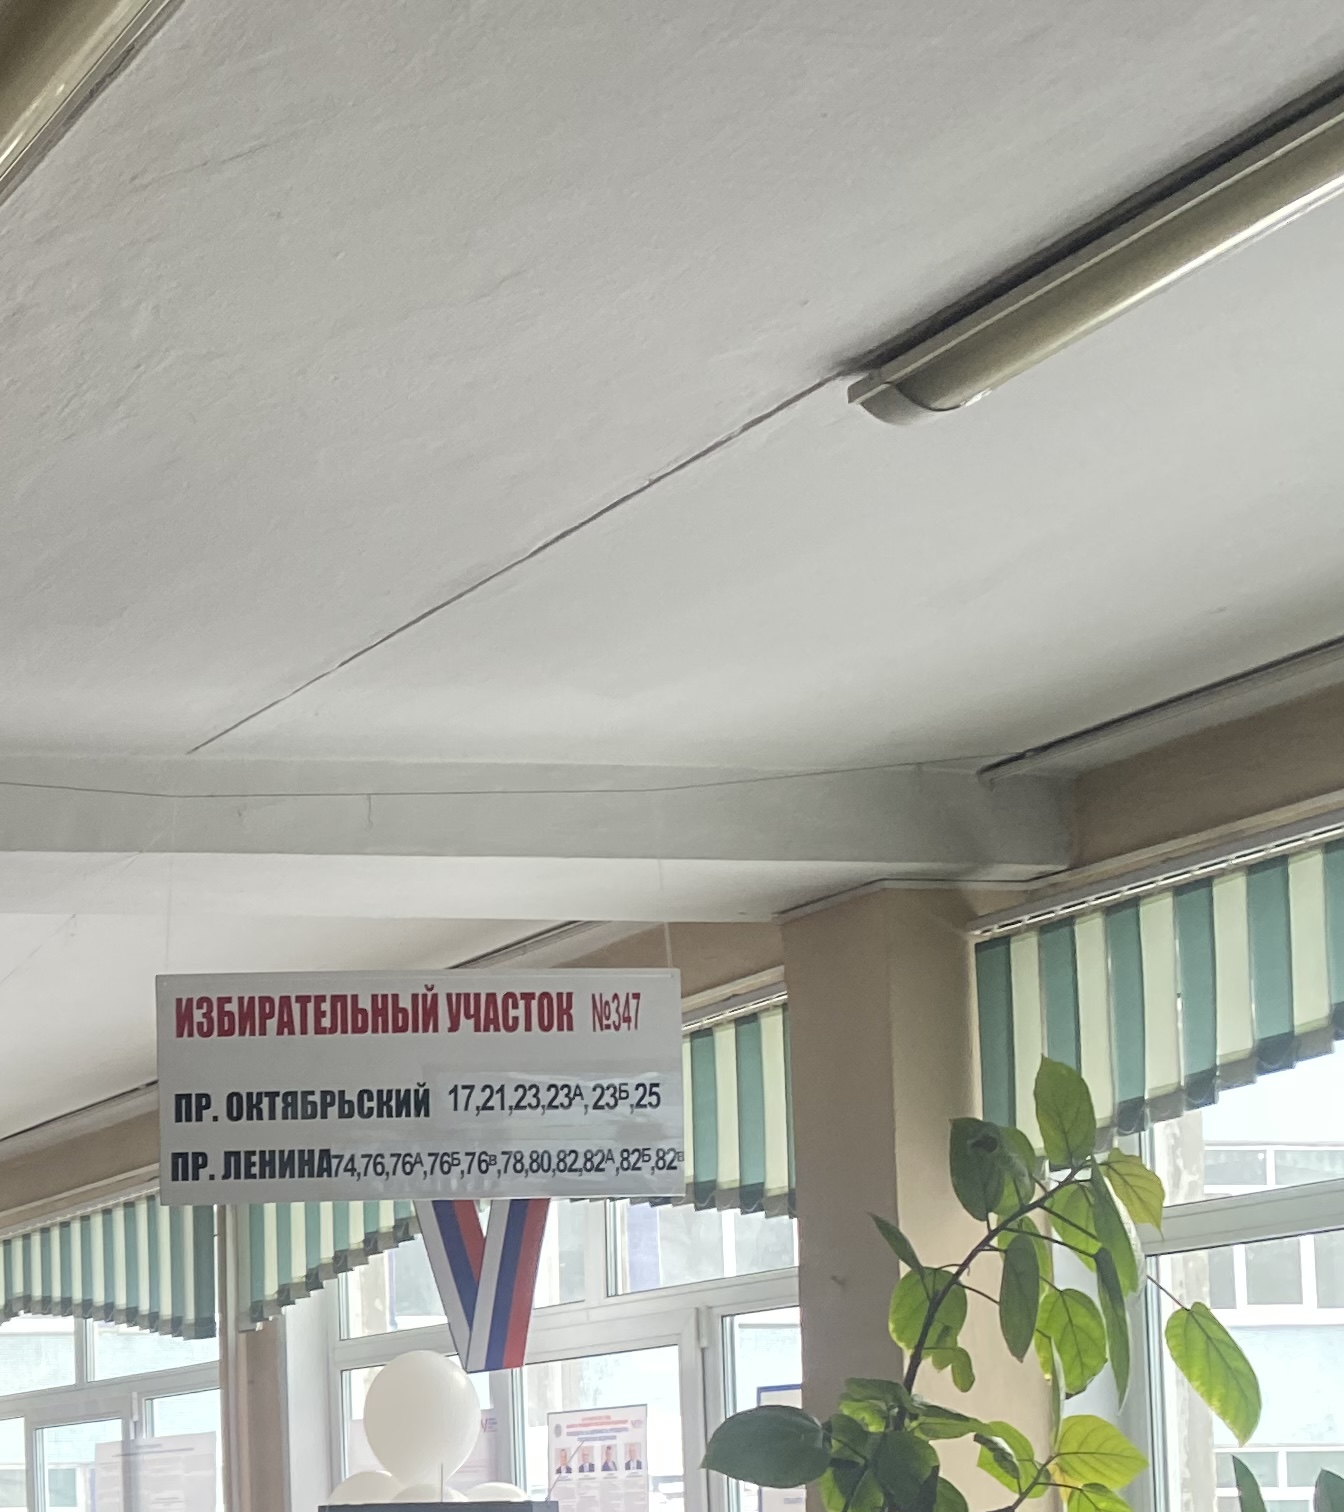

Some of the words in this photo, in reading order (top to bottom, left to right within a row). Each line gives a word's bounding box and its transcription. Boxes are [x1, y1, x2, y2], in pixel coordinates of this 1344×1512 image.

[175, 984, 439, 1038] ИЗБИРАТЕЛЬНЫЙ
[446, 991, 574, 1034] УЧАСТОК
[591, 991, 642, 1033] №347
[174, 1093, 219, 1123] ПР.
[226, 1082, 430, 1122] ОКТЯБРЬСКИЙ
[171, 1152, 215, 1182] ПР.
[221, 1149, 332, 1181] ЛЕНИНА
